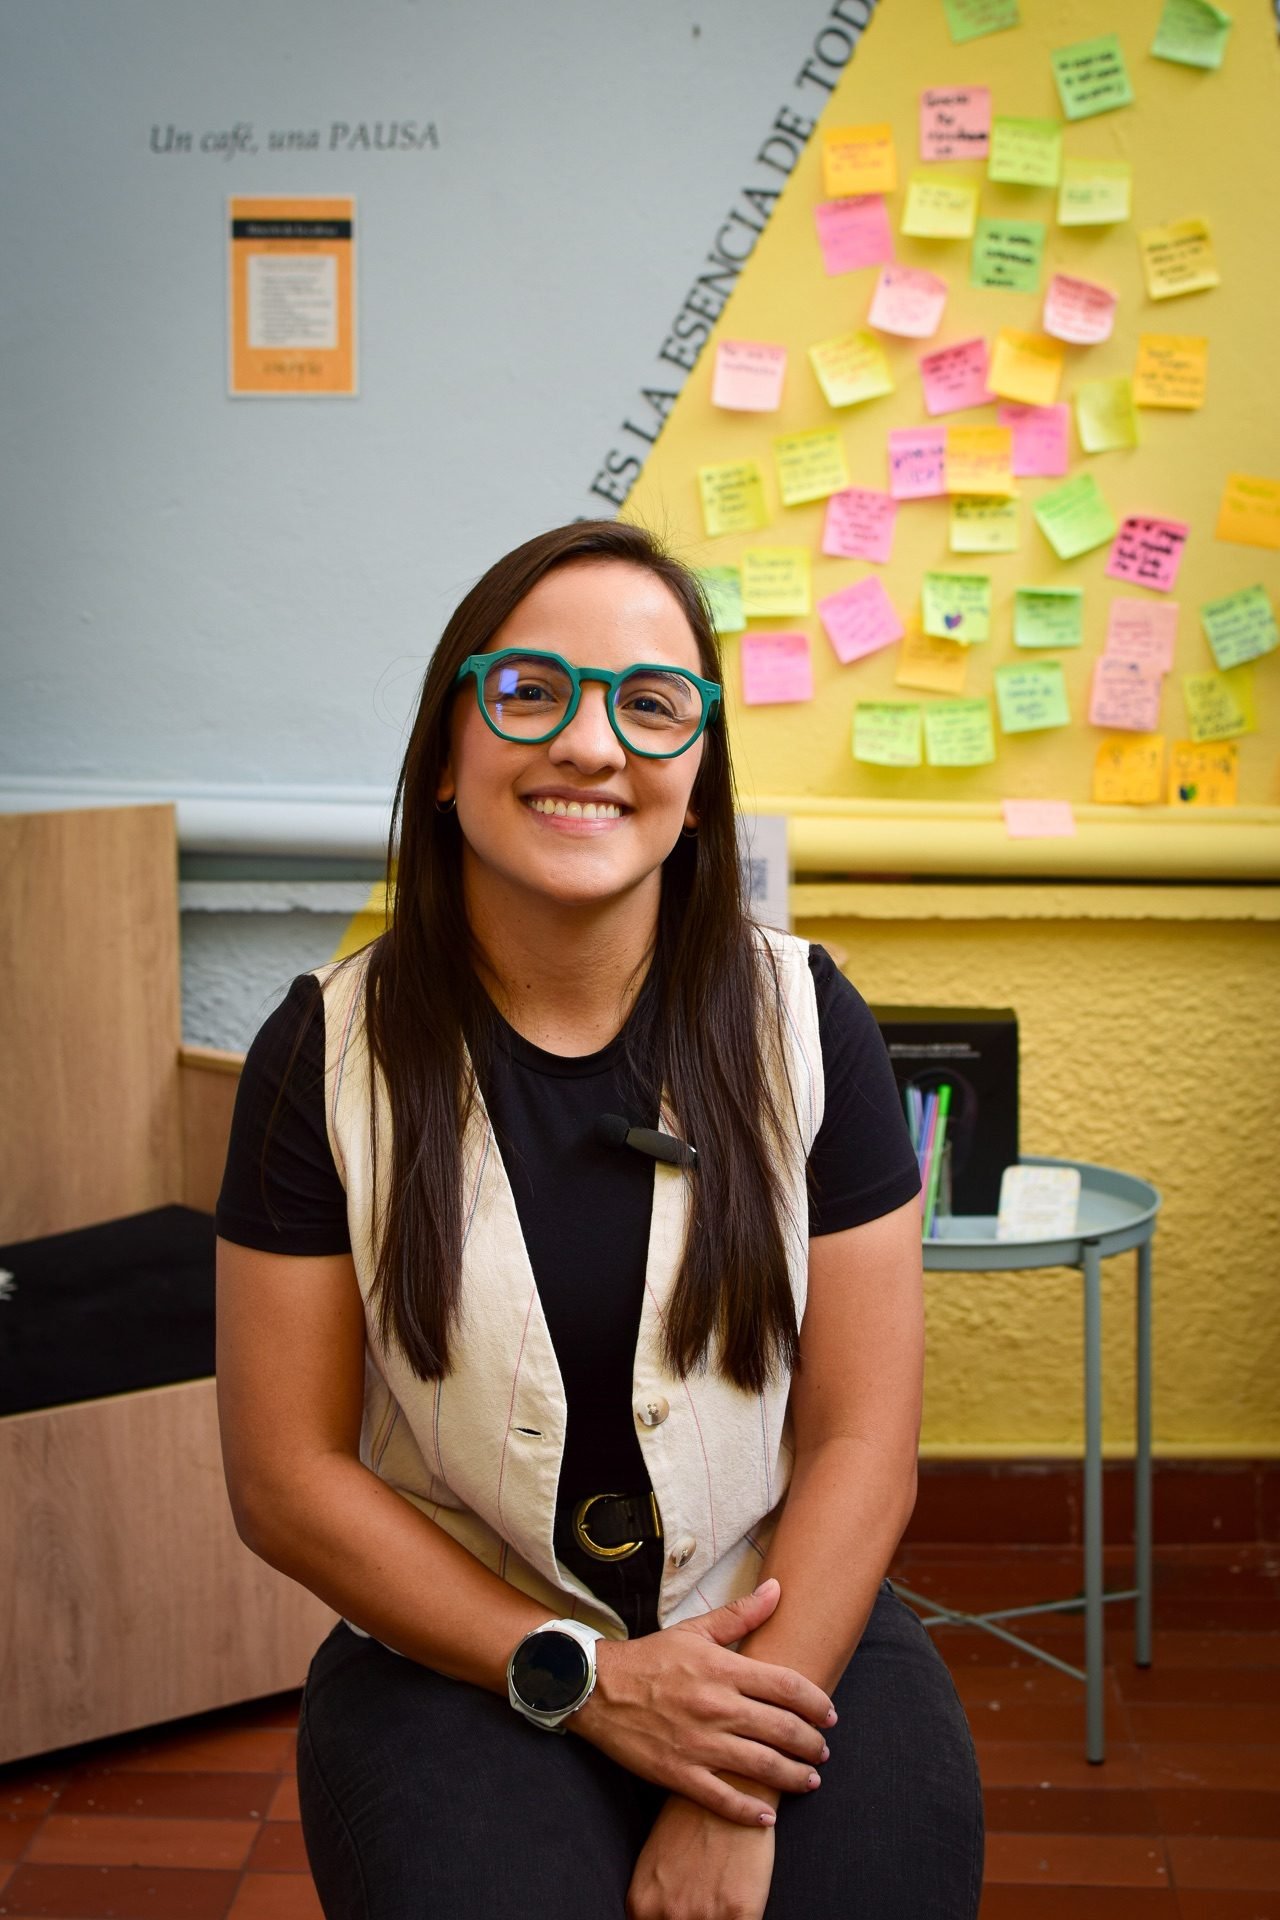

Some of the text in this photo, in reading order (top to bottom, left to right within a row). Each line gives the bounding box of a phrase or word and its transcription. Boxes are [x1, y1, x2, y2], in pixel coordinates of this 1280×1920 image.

[149, 120, 440, 162] Un café, una PAUSA
[590, 449, 642, 506] ES
[622, 388, 680, 443] LA
[659, 187, 781, 372] ESENCIA
[756, 104, 818, 176] DE
[796, 0, 881, 91] TOD
